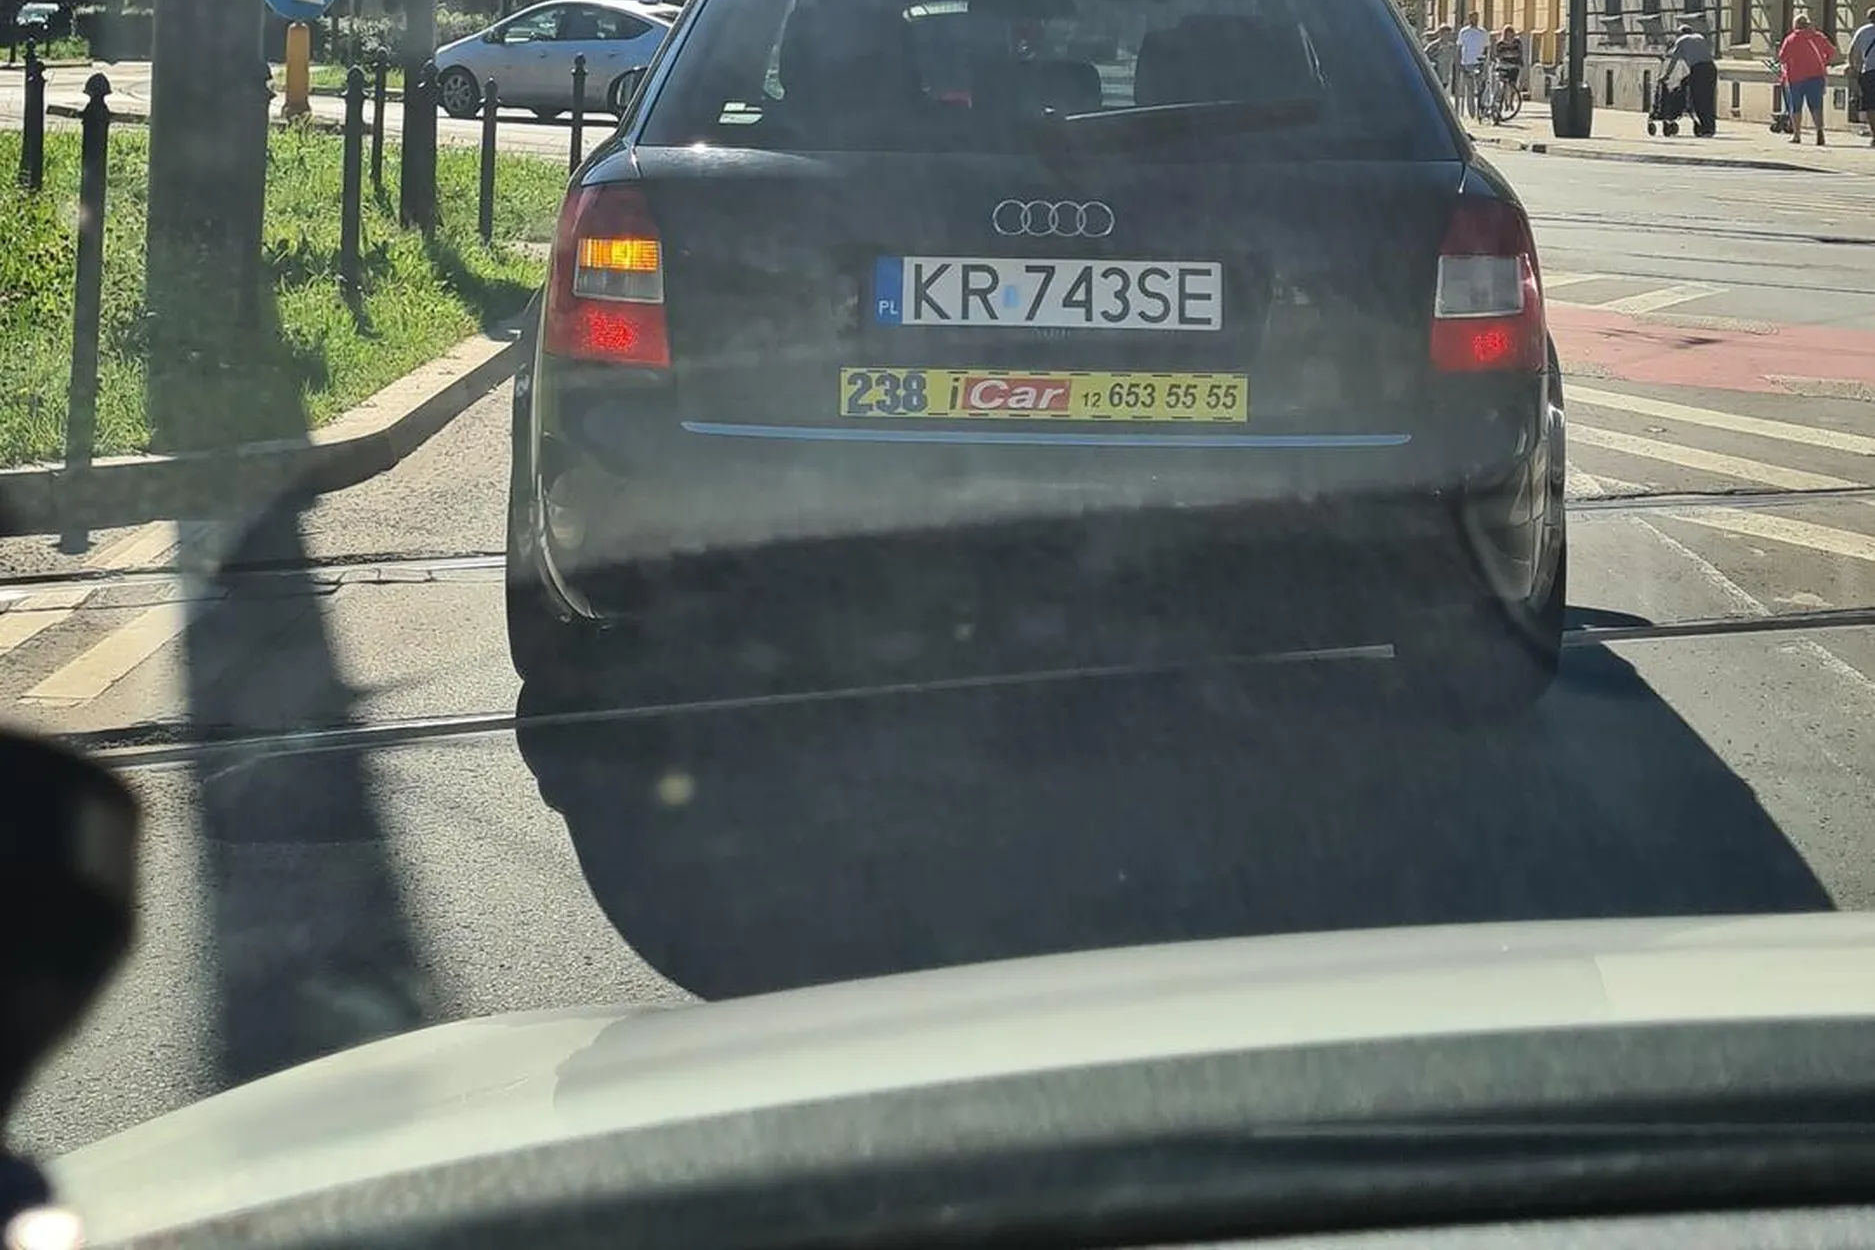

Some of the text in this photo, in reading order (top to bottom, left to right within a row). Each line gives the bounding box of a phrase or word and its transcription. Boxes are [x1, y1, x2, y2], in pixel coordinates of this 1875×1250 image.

[878, 300, 899, 316] PL
[914, 263, 1213, 326] KR 743SE
[847, 371, 928, 415] 238
[1082, 392, 1101, 408] 12
[1109, 383, 1155, 408] 653
[1166, 384, 1198, 409] 55
[1206, 384, 1238, 410] 55
